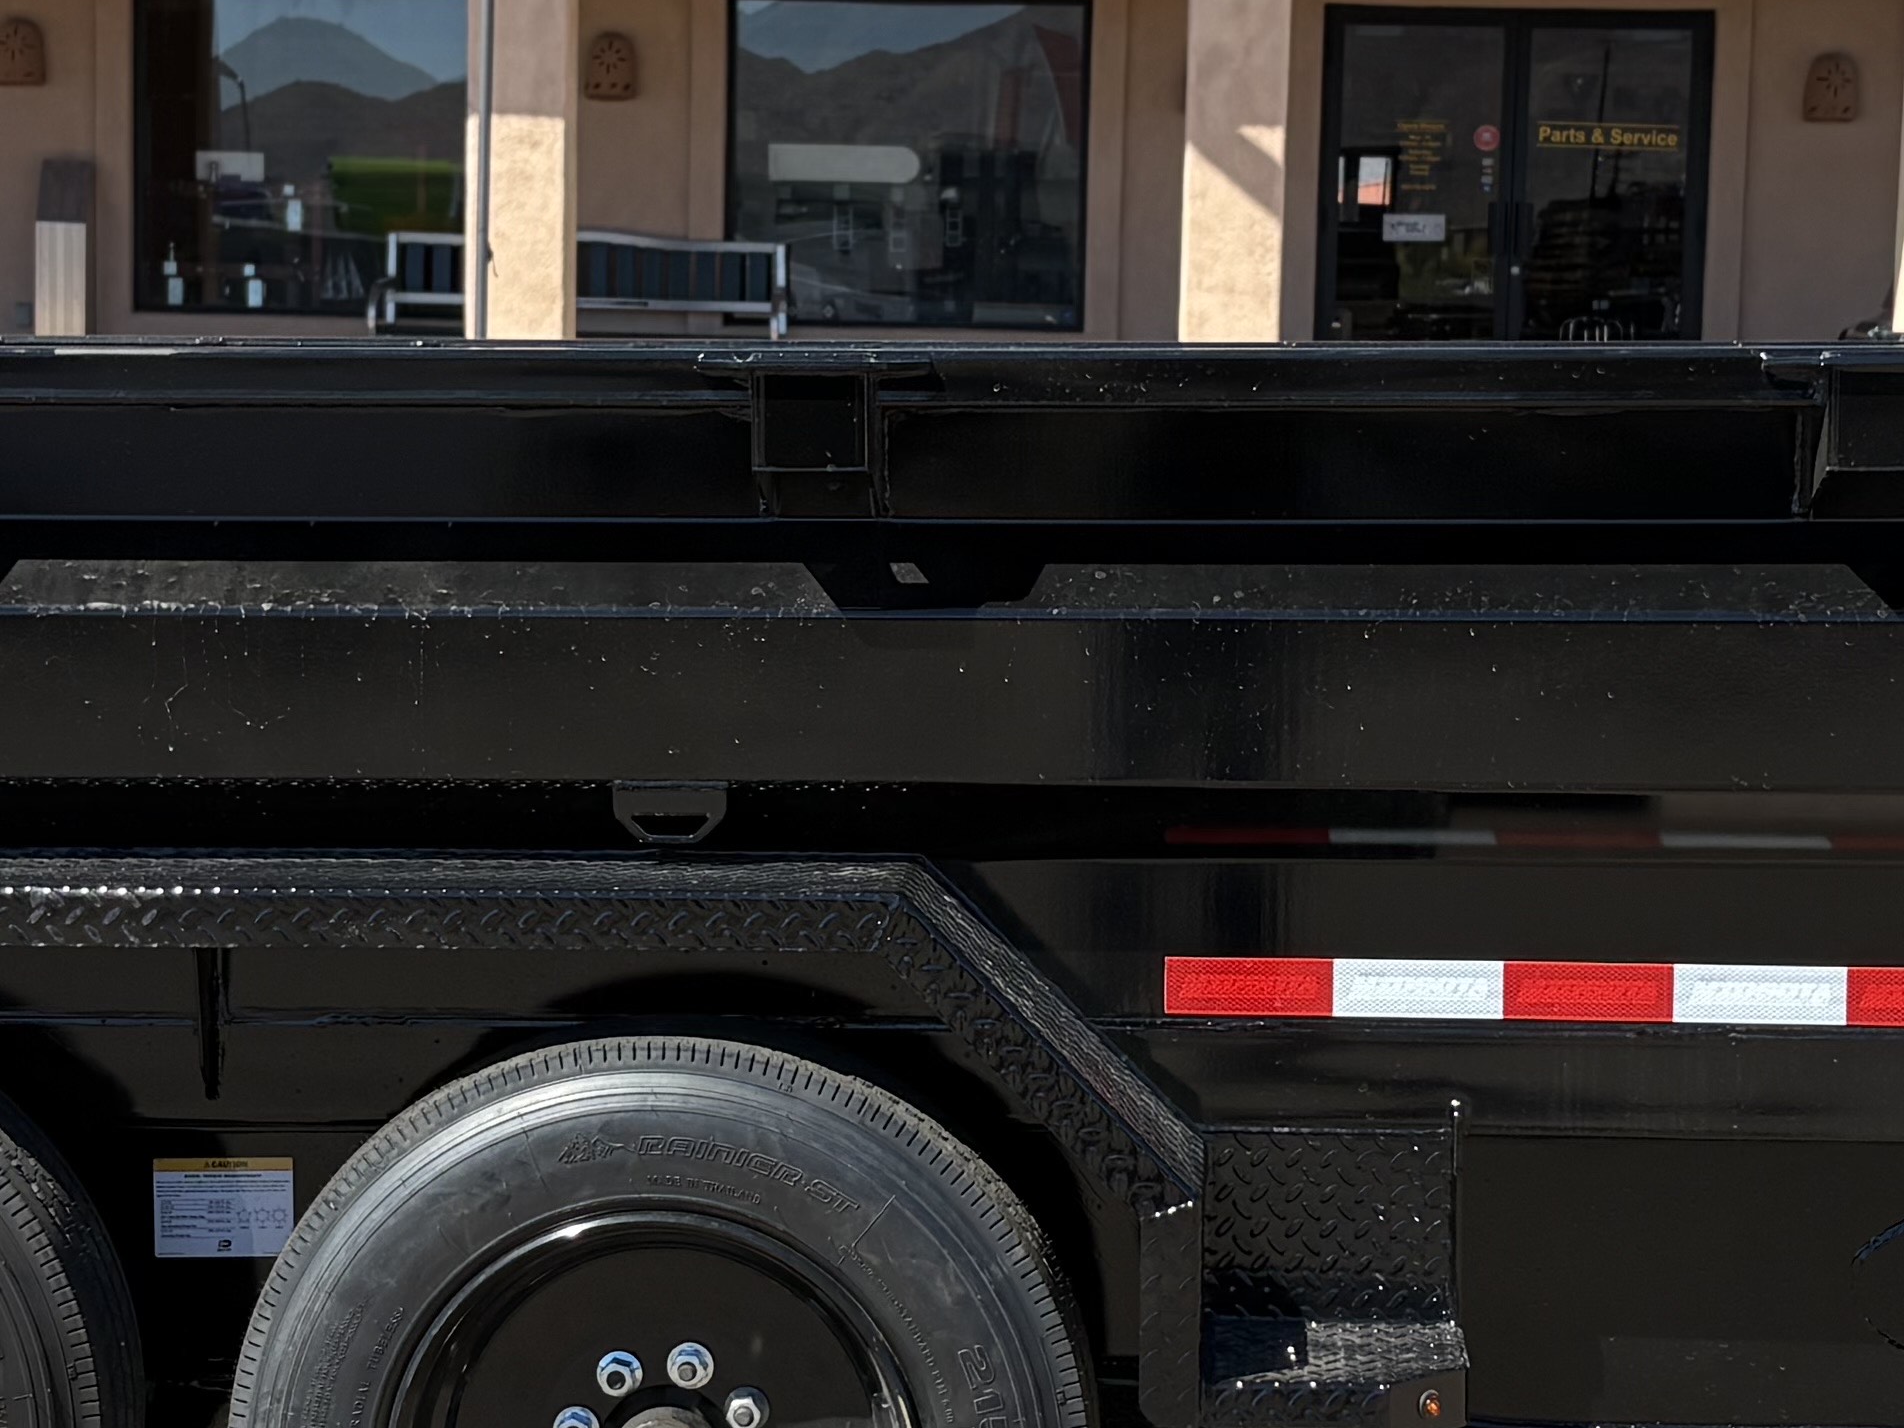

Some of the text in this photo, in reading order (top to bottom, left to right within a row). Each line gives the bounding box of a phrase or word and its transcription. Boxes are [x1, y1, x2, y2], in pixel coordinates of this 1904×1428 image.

[1538, 126, 1678, 146] Parts & Service
